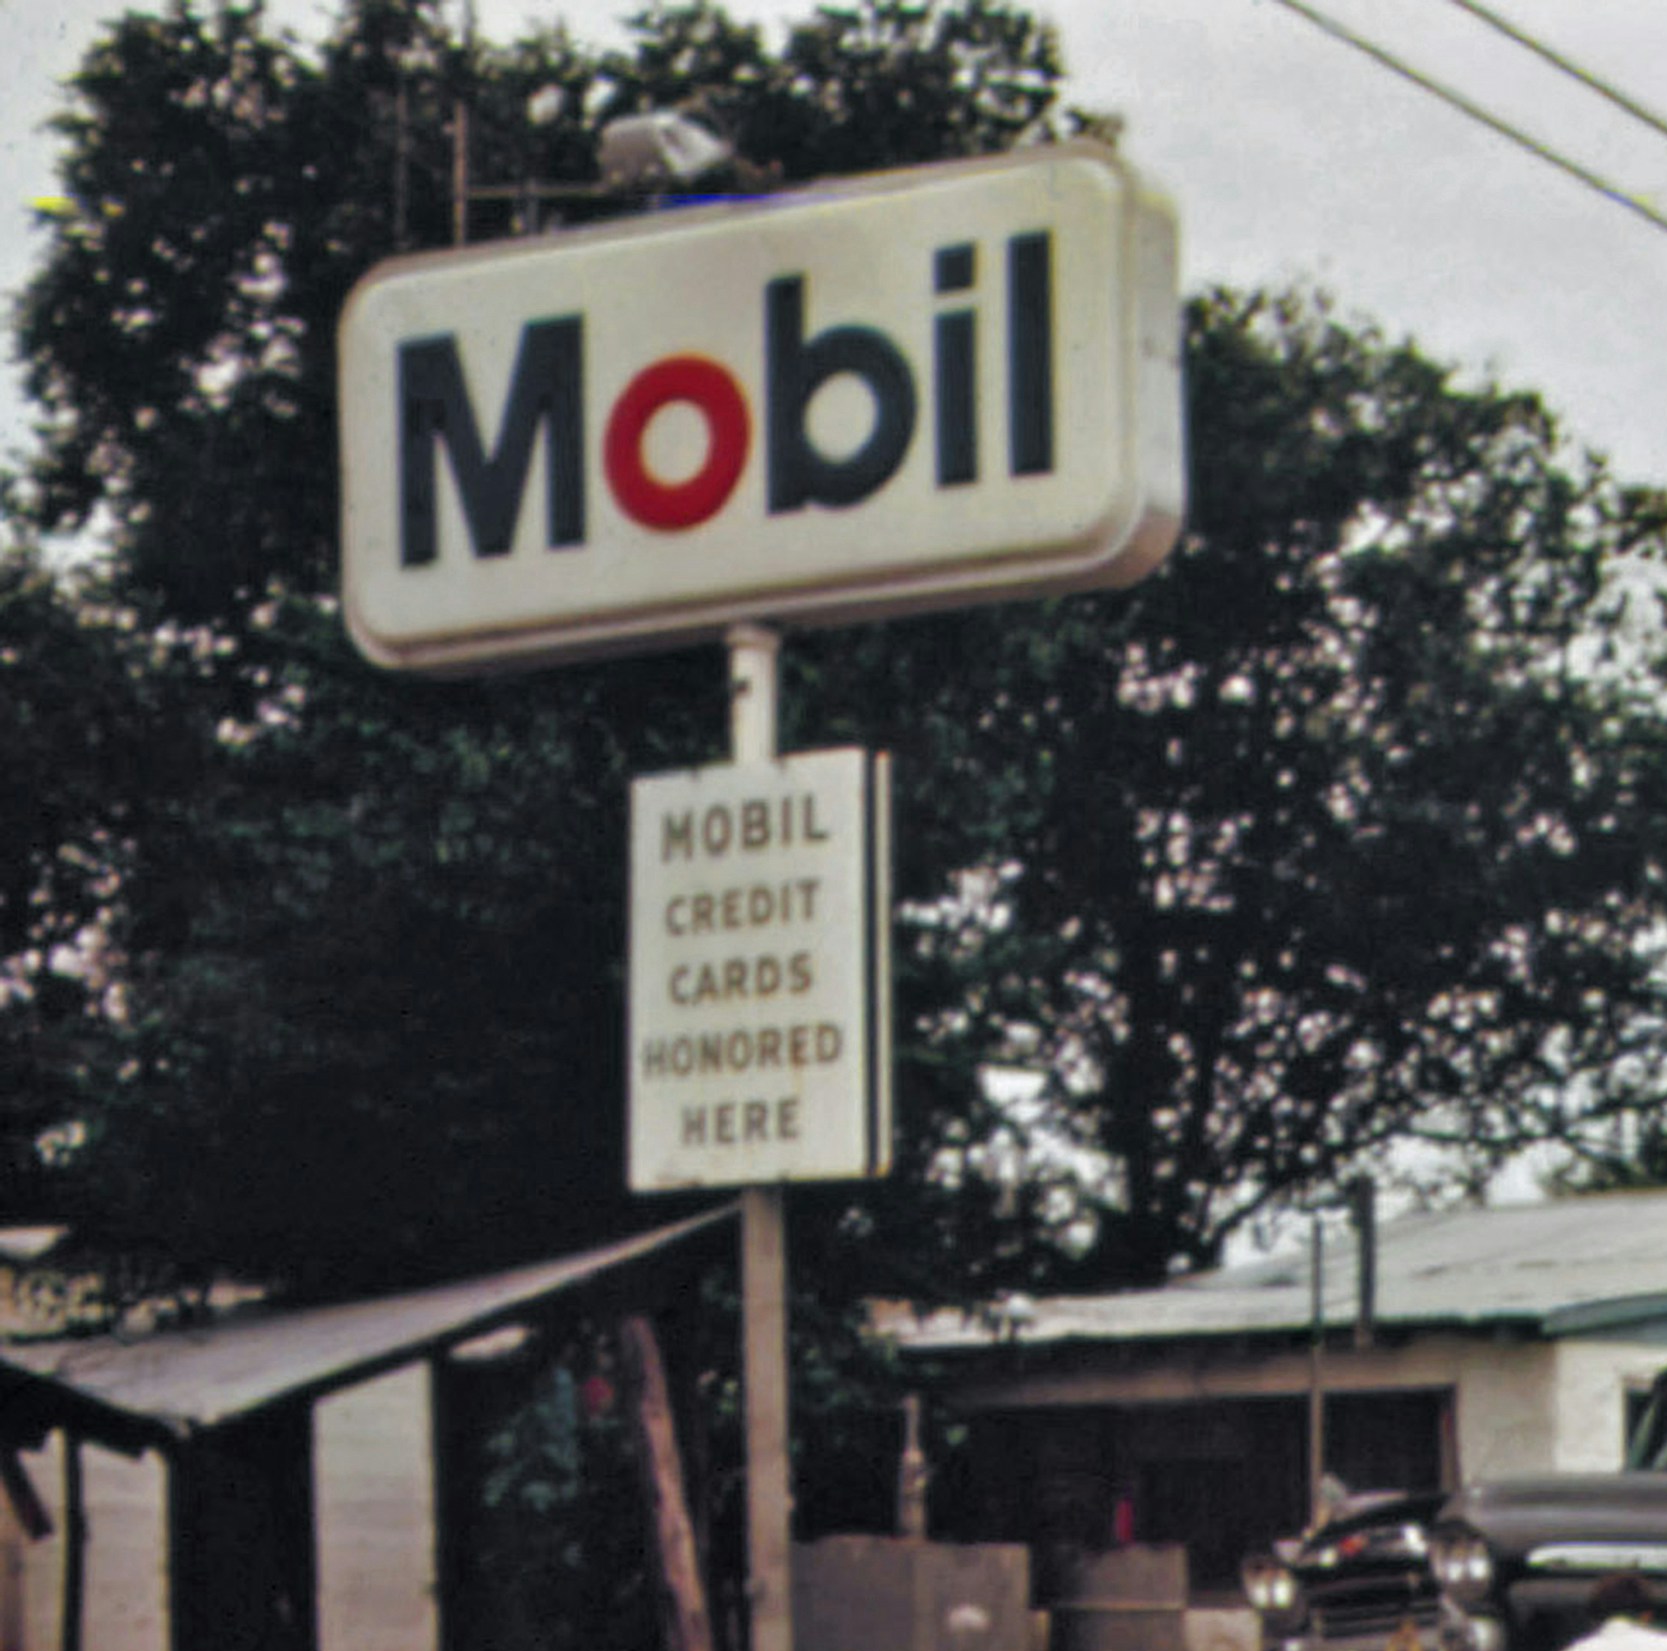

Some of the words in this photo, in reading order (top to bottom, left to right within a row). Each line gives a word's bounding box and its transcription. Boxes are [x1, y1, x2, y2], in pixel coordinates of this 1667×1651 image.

[397, 230, 1055, 569] Mobil
[662, 792, 829, 863] MOBIL
[665, 879, 822, 936] CREDIT
[669, 953, 813, 1005] CARDS
[643, 1024, 842, 1078] HONORED
[682, 1099, 801, 1146] HERE
